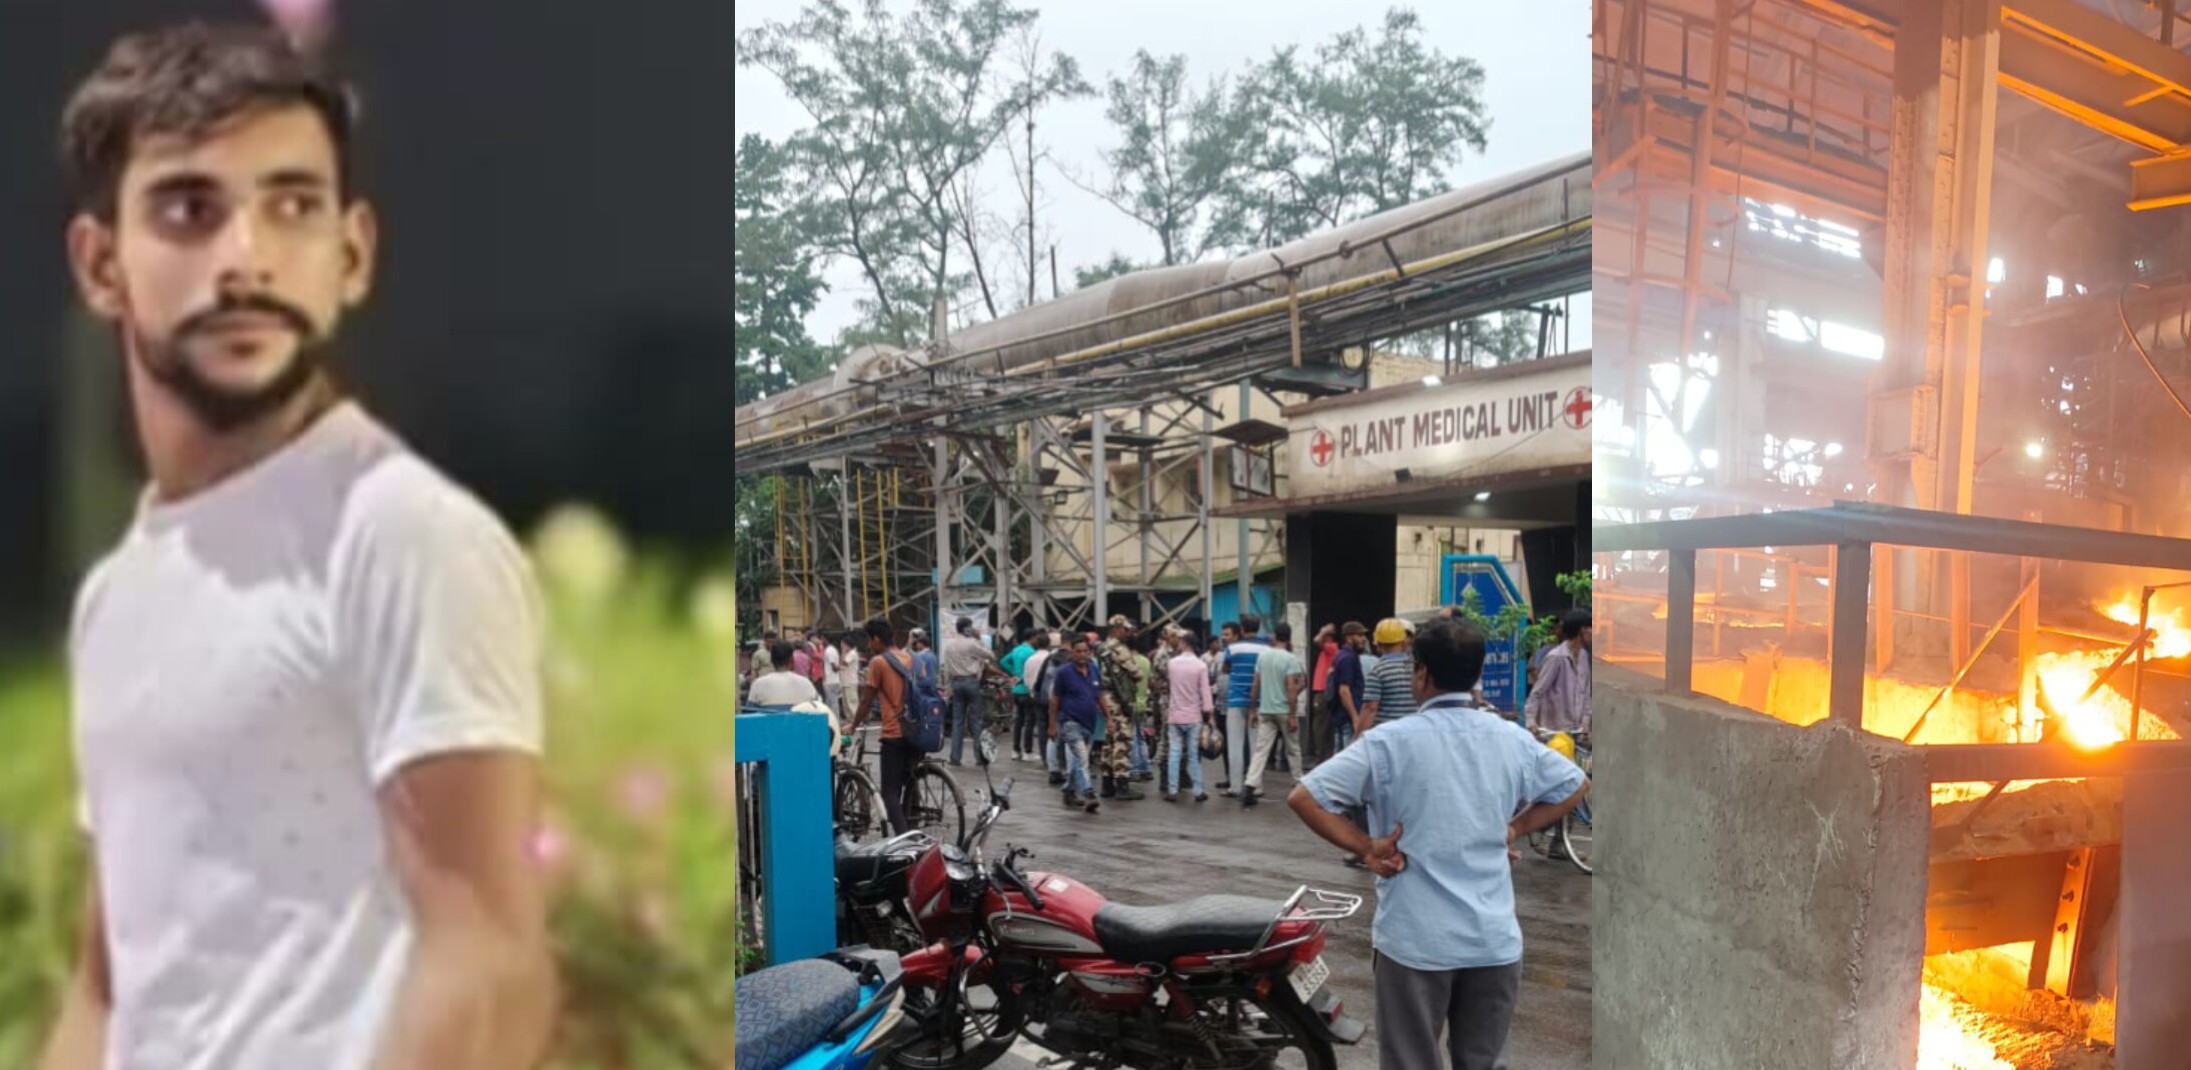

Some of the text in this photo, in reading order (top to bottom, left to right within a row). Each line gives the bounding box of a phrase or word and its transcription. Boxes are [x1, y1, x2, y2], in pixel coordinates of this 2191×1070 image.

[1341, 391, 1558, 458] PLANT MEDICAL UNIT
